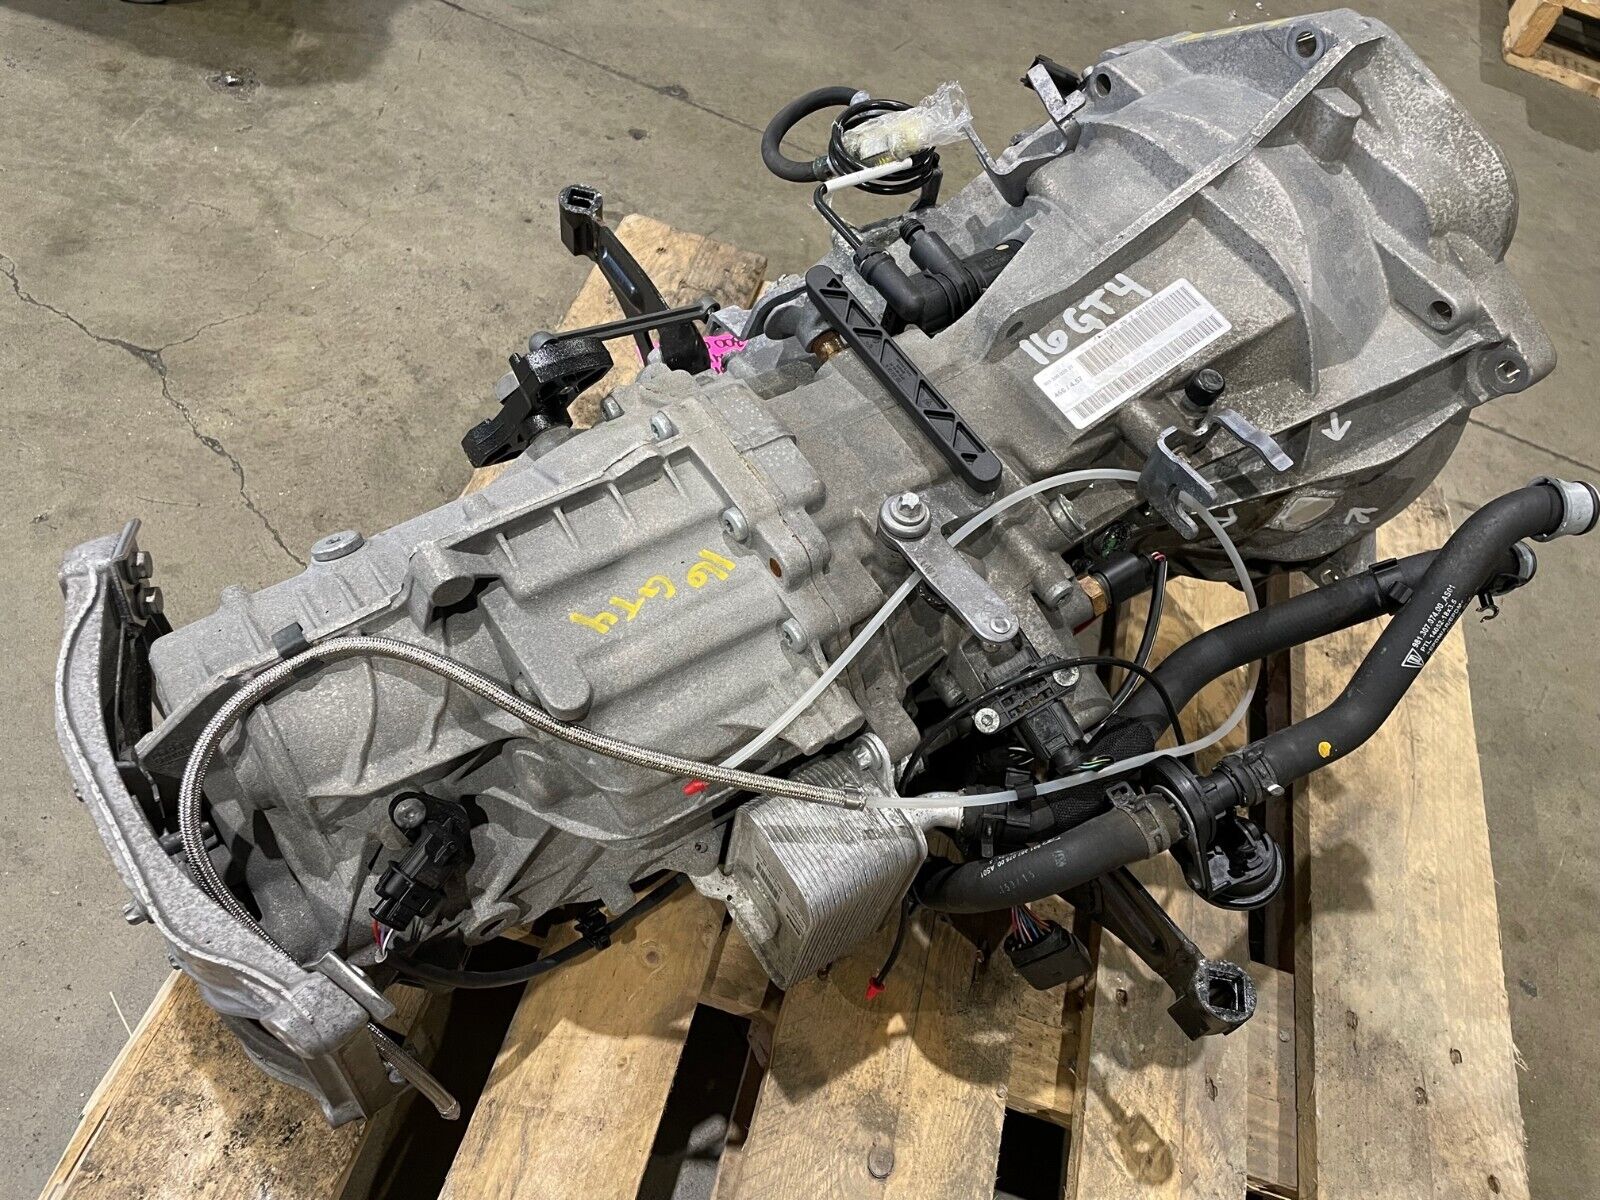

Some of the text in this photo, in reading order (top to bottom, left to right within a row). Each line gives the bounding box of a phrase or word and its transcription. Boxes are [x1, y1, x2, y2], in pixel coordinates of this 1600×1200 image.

[1018, 329, 1068, 365] 16
[569, 548, 736, 635] 16 GT4
[1420, 640, 1433, 653] PTL
